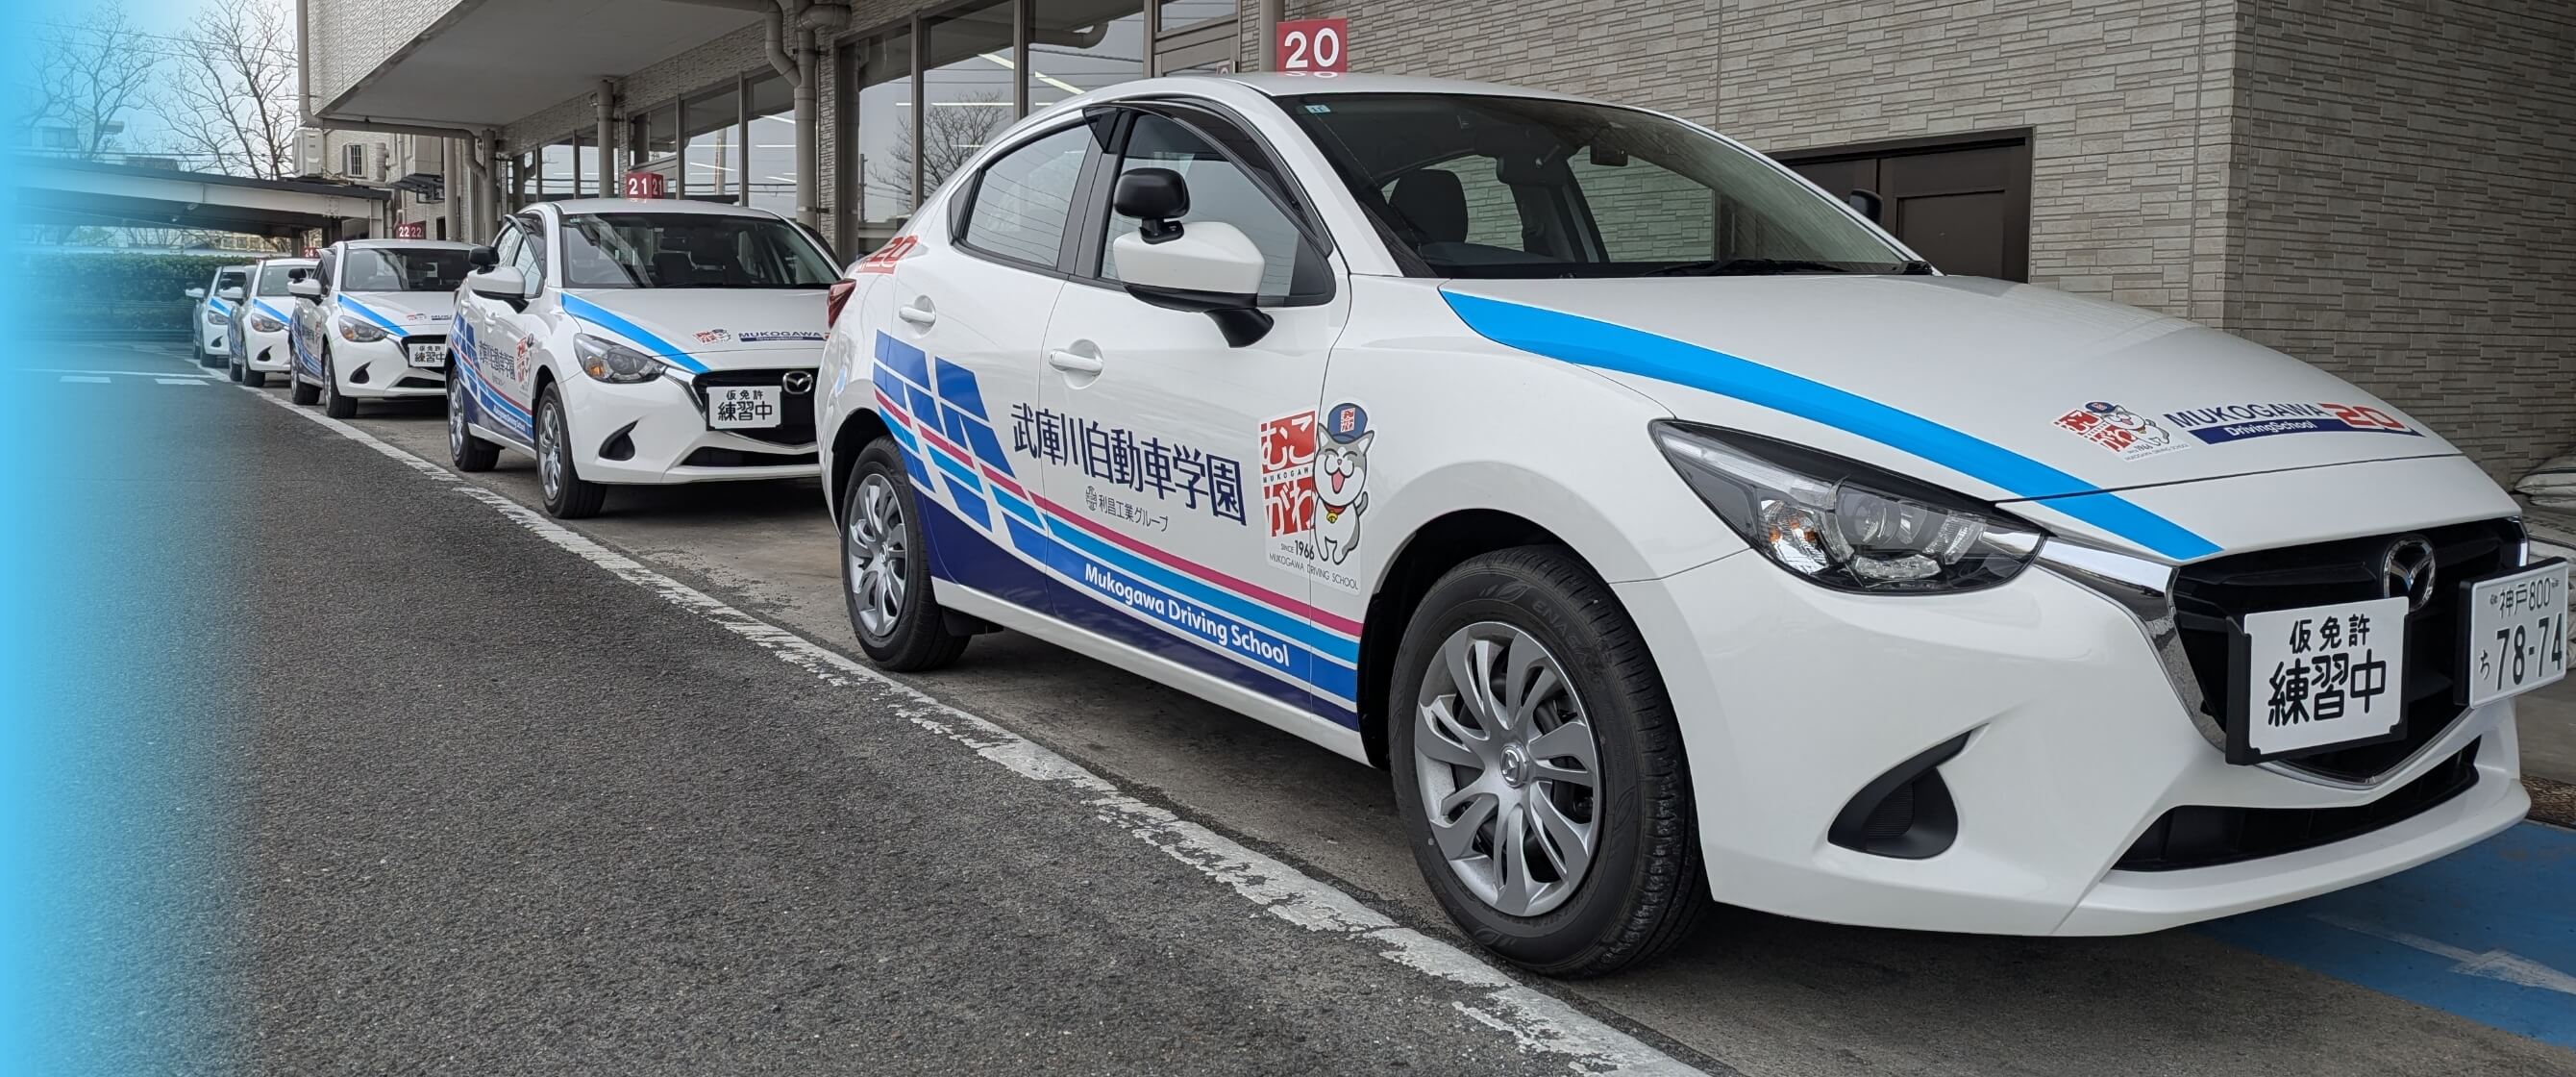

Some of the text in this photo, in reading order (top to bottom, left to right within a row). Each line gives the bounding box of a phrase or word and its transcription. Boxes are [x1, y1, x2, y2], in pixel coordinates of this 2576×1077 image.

[1284, 28, 1339, 68] 20
[629, 178, 647, 195] 21
[653, 178, 662, 195] 21
[399, 226, 409, 238] 22
[411, 226, 422, 238] 22
[718, 400, 773, 421] 練習中
[2163, 403, 2405, 429] MUKOGAWA 20
[1010, 402, 1248, 527] 武庫川自動車学園
[1280, 539, 1315, 561] SINCE 1966
[1270, 553, 1359, 590] MUKOGAWA DRIVING SCHOOL
[1085, 564, 1290, 667] Mukogawa Driving School
[2290, 614, 2370, 654] 仮免許
[2496, 613, 2563, 691] 78-74
[2267, 648, 2387, 727] 練習中
